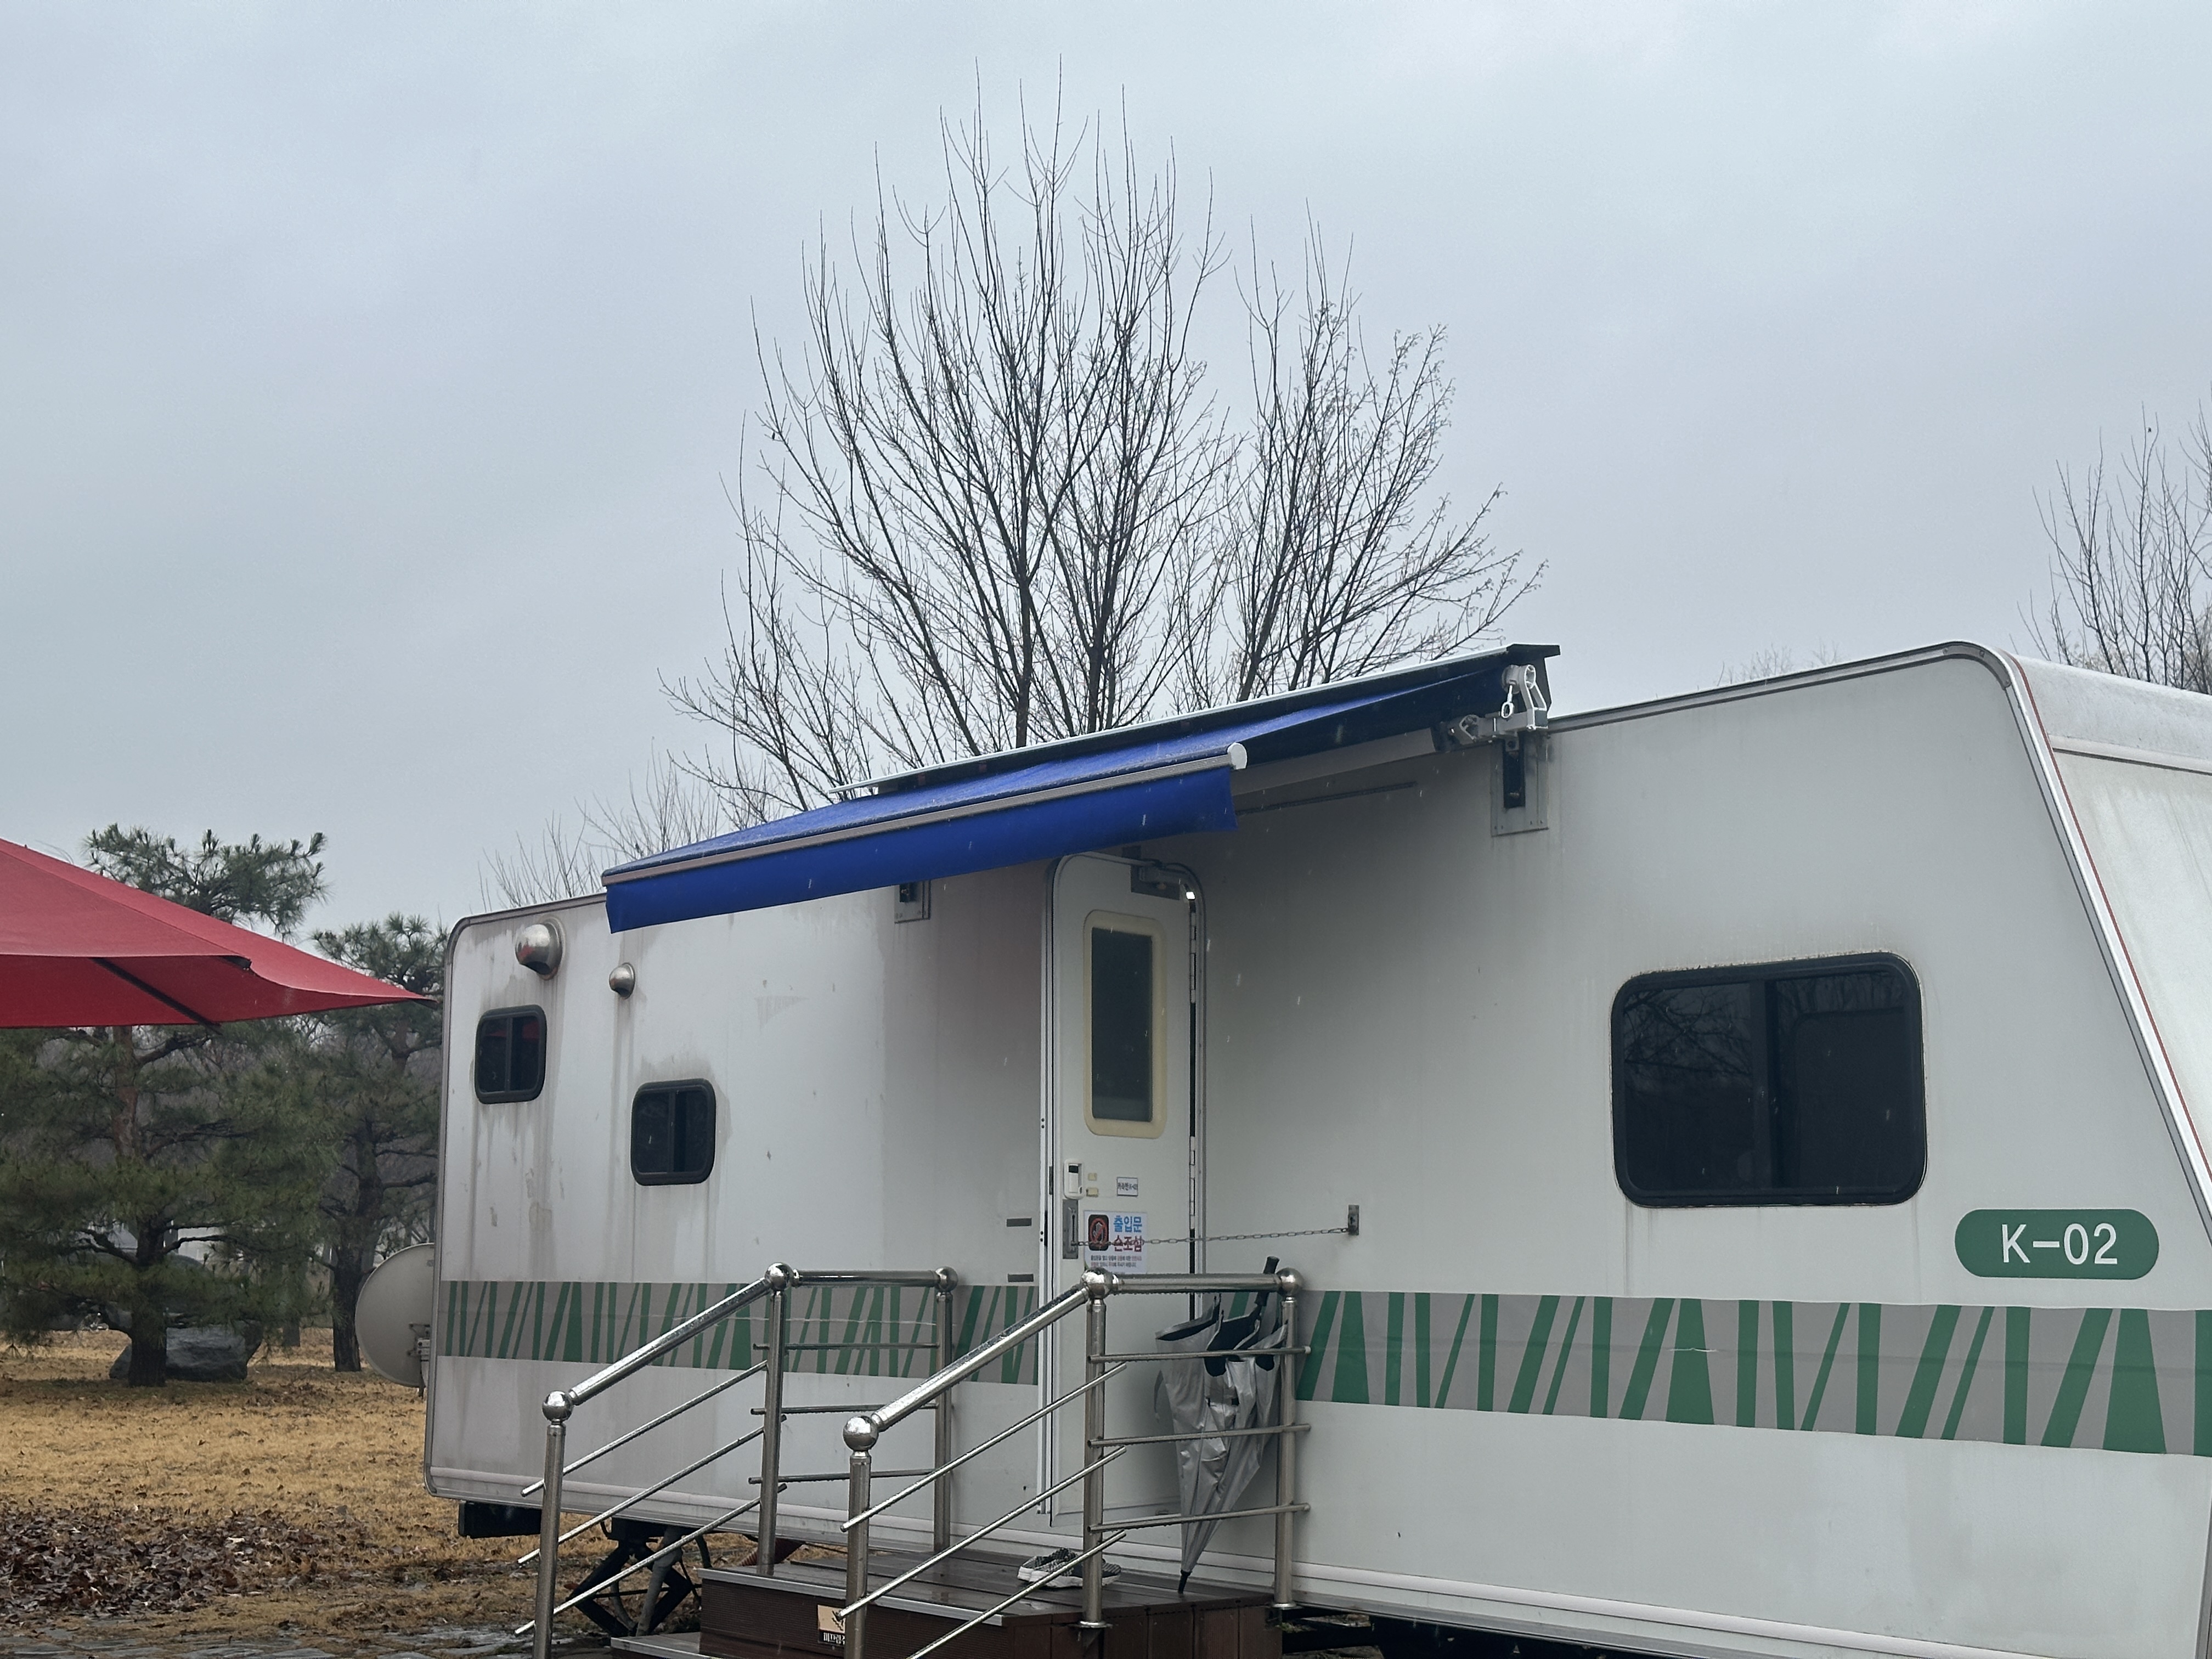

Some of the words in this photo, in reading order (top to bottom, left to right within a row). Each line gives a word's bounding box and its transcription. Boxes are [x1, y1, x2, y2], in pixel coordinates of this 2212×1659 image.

[1113, 1215, 1142, 1232] 출입문
[1114, 1234, 1142, 1252] 손조심
[2001, 1223, 2118, 1265] K-02
